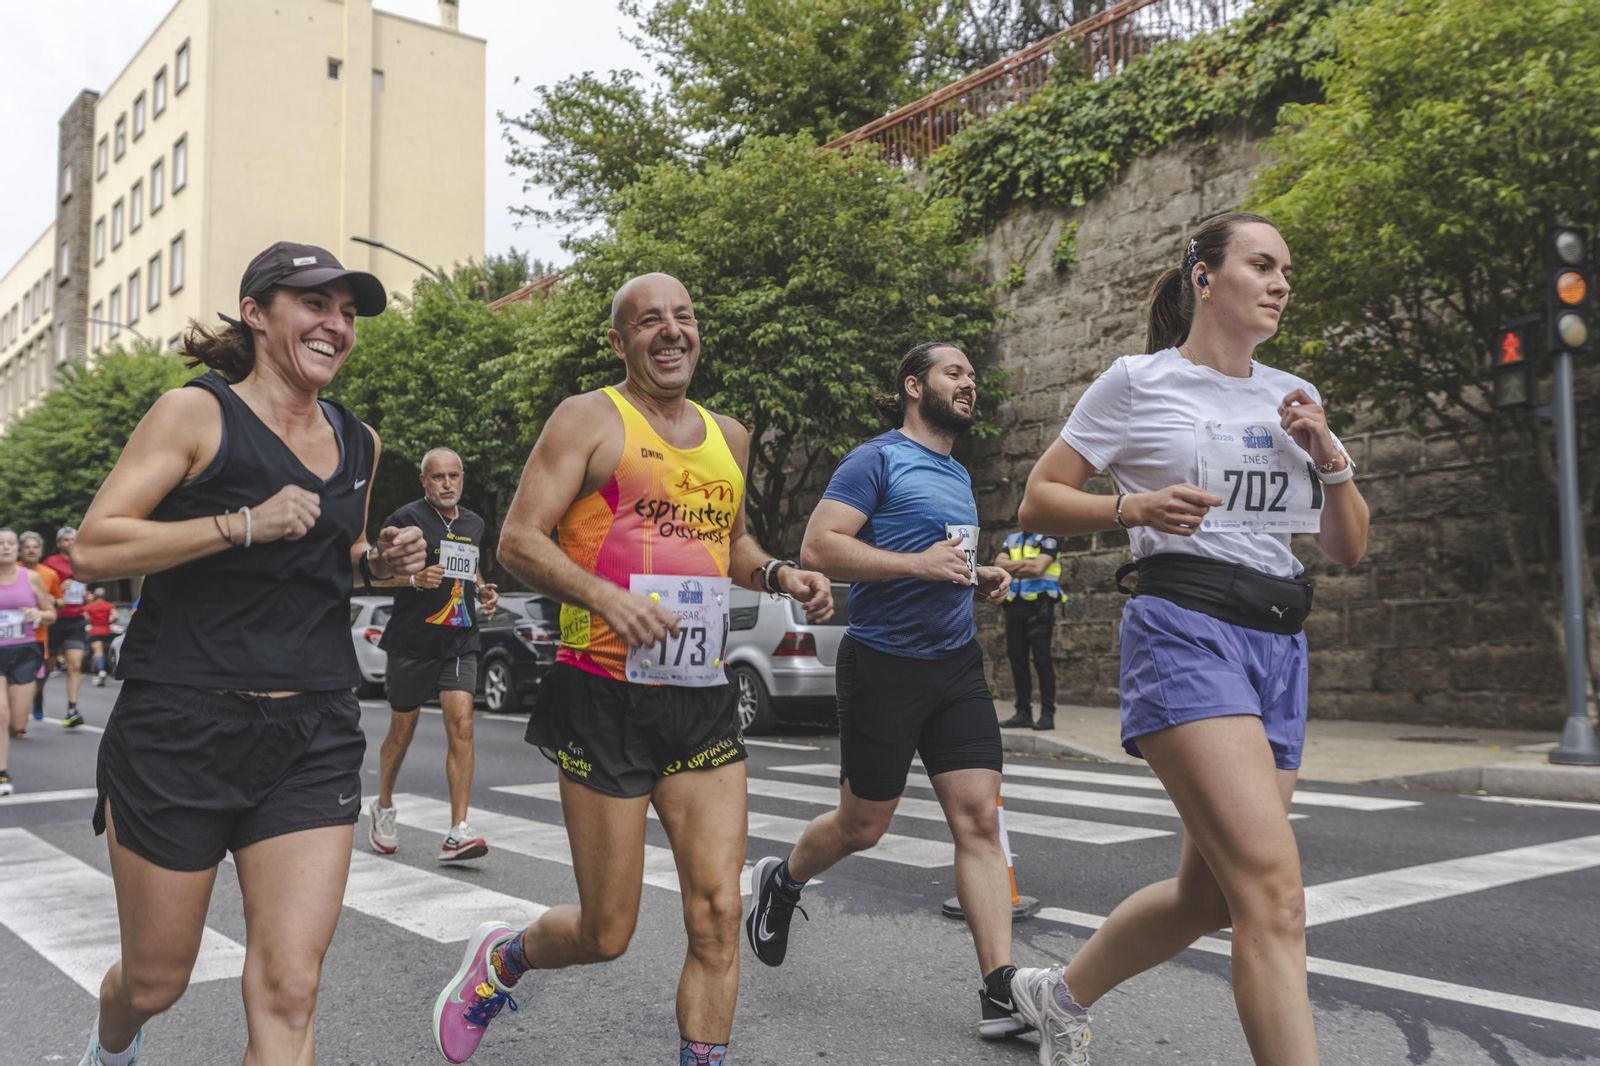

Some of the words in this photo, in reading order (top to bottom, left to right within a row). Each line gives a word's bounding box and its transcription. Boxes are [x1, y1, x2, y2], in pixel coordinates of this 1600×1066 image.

[1211, 433, 1234, 441] 2026
[1242, 454, 1269, 465] INÉS
[1224, 470, 1289, 512] 702
[446, 556, 470, 573] 1008
